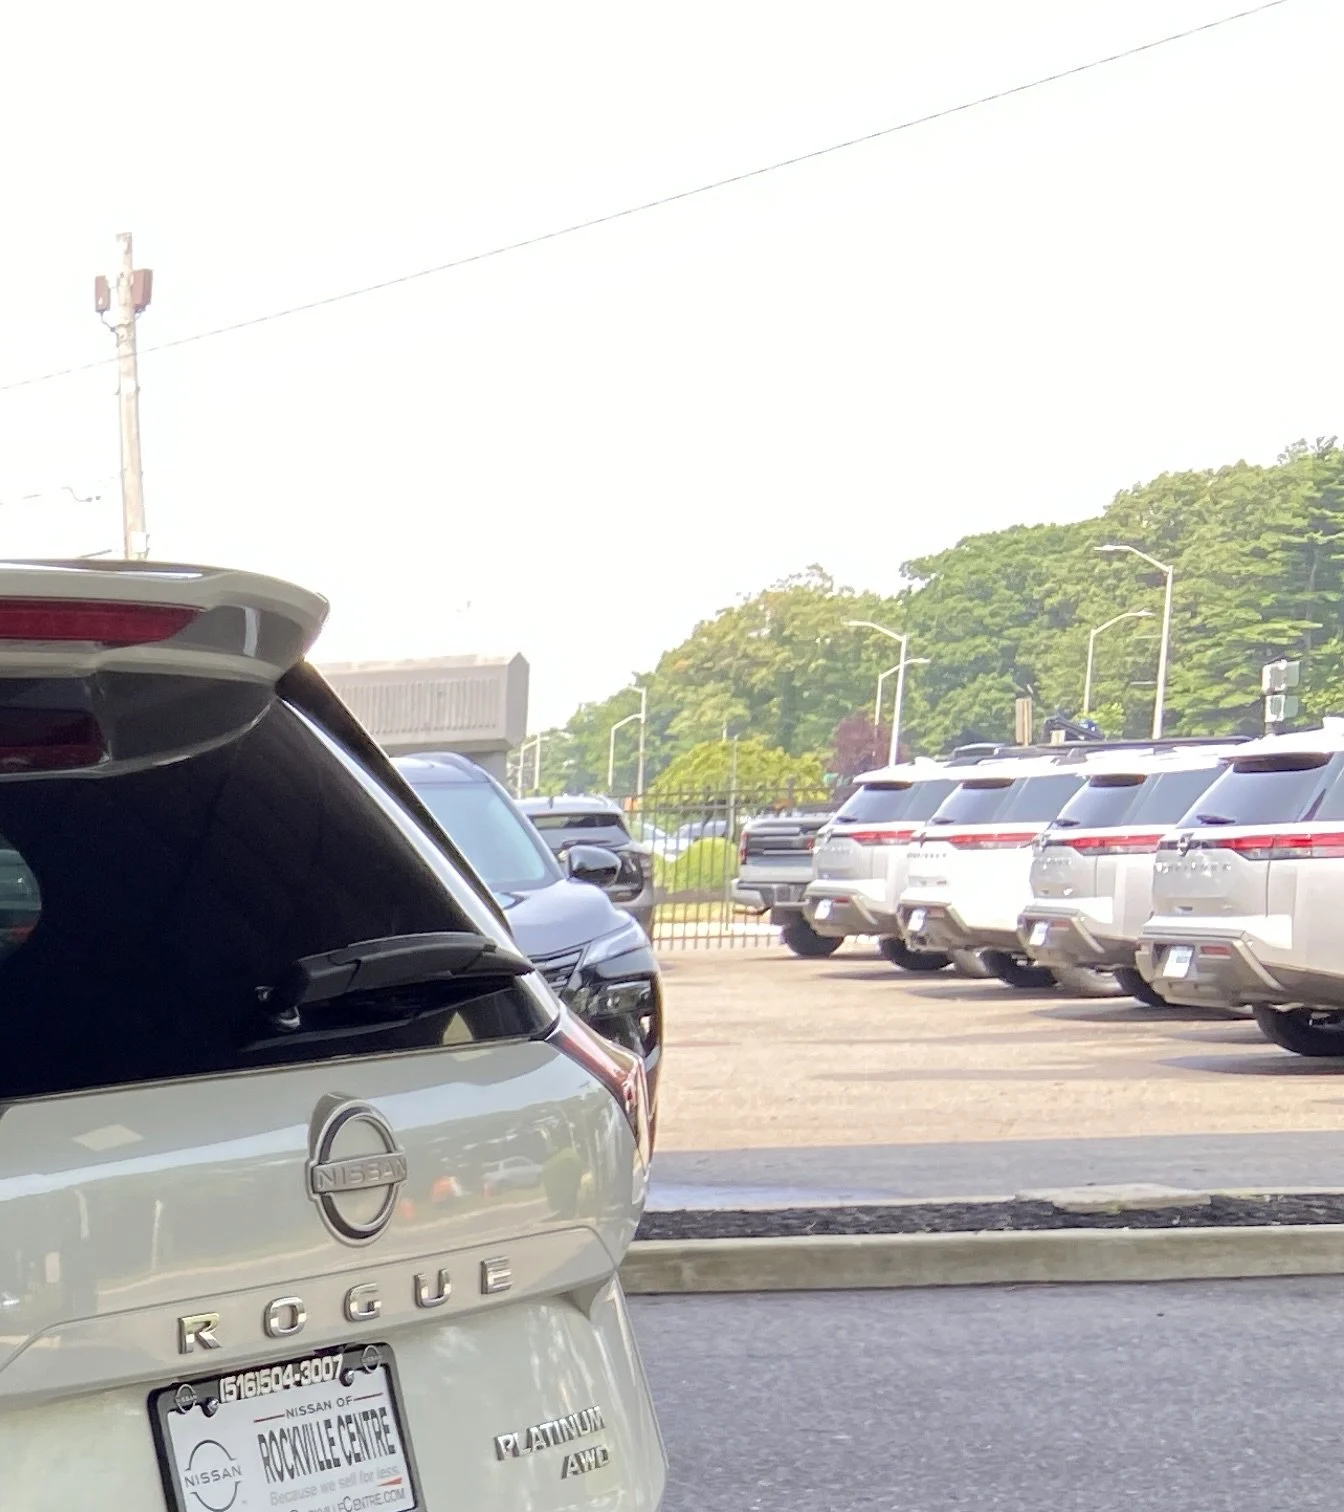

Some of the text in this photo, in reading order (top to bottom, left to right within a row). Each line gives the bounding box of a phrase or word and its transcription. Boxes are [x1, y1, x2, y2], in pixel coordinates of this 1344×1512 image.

[316, 1157, 408, 1188] NISSAN
[178, 1256, 513, 1355] ROGUE
[219, 1354, 344, 1404] (516)504-3007
[284, 1395, 353, 1419] NISSAN OF
[258, 1406, 397, 1485] ROCKVILLE CENTRE
[494, 1405, 606, 1462] PLATINUM
[184, 1463, 242, 1488] NISSAN
[561, 1443, 610, 1480] AWD
[270, 1484, 318, 1507] Because
[320, 1480, 336, 1495] we
[338, 1472, 358, 1490] sell
[359, 1469, 374, 1484] for
